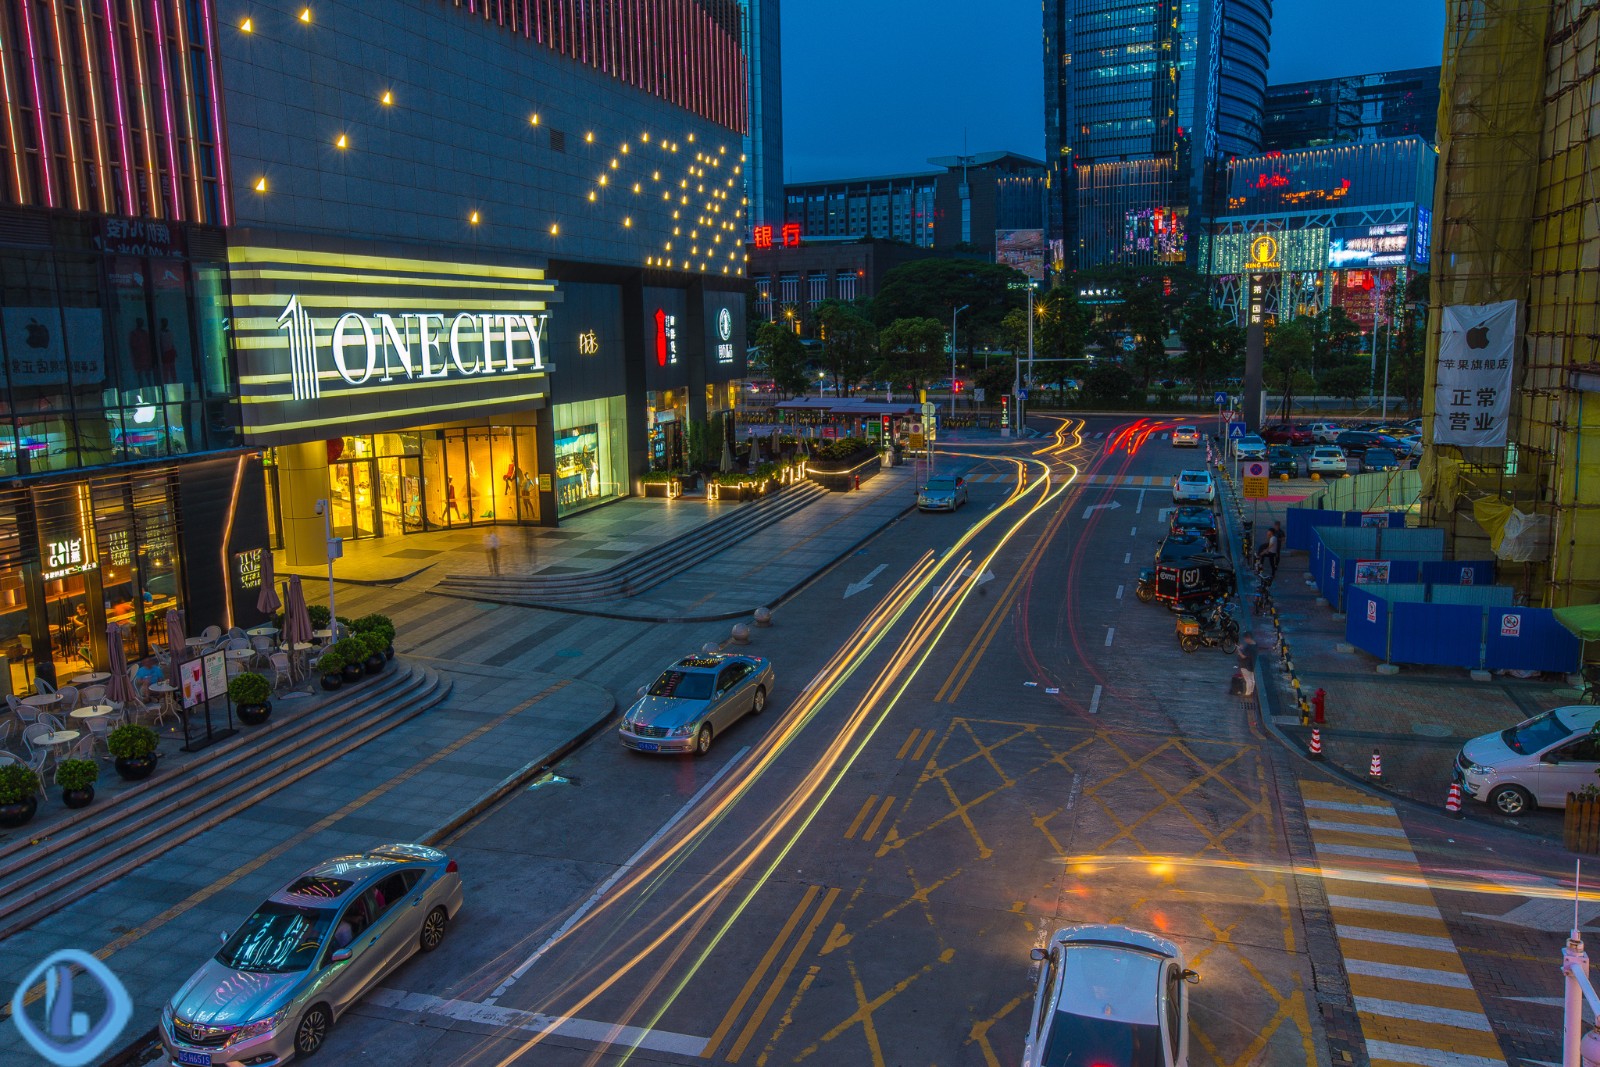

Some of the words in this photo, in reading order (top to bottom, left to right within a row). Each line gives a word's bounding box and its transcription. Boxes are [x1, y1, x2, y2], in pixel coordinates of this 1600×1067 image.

[754, 223, 800, 247] 银行
[1251, 285, 1262, 324] 第一国际
[332, 312, 548, 385] ONECITY
[1443, 358, 1509, 371] 苹果旗舰店
[1450, 387, 1497, 408] 正常
[1449, 412, 1495, 431] 营业
